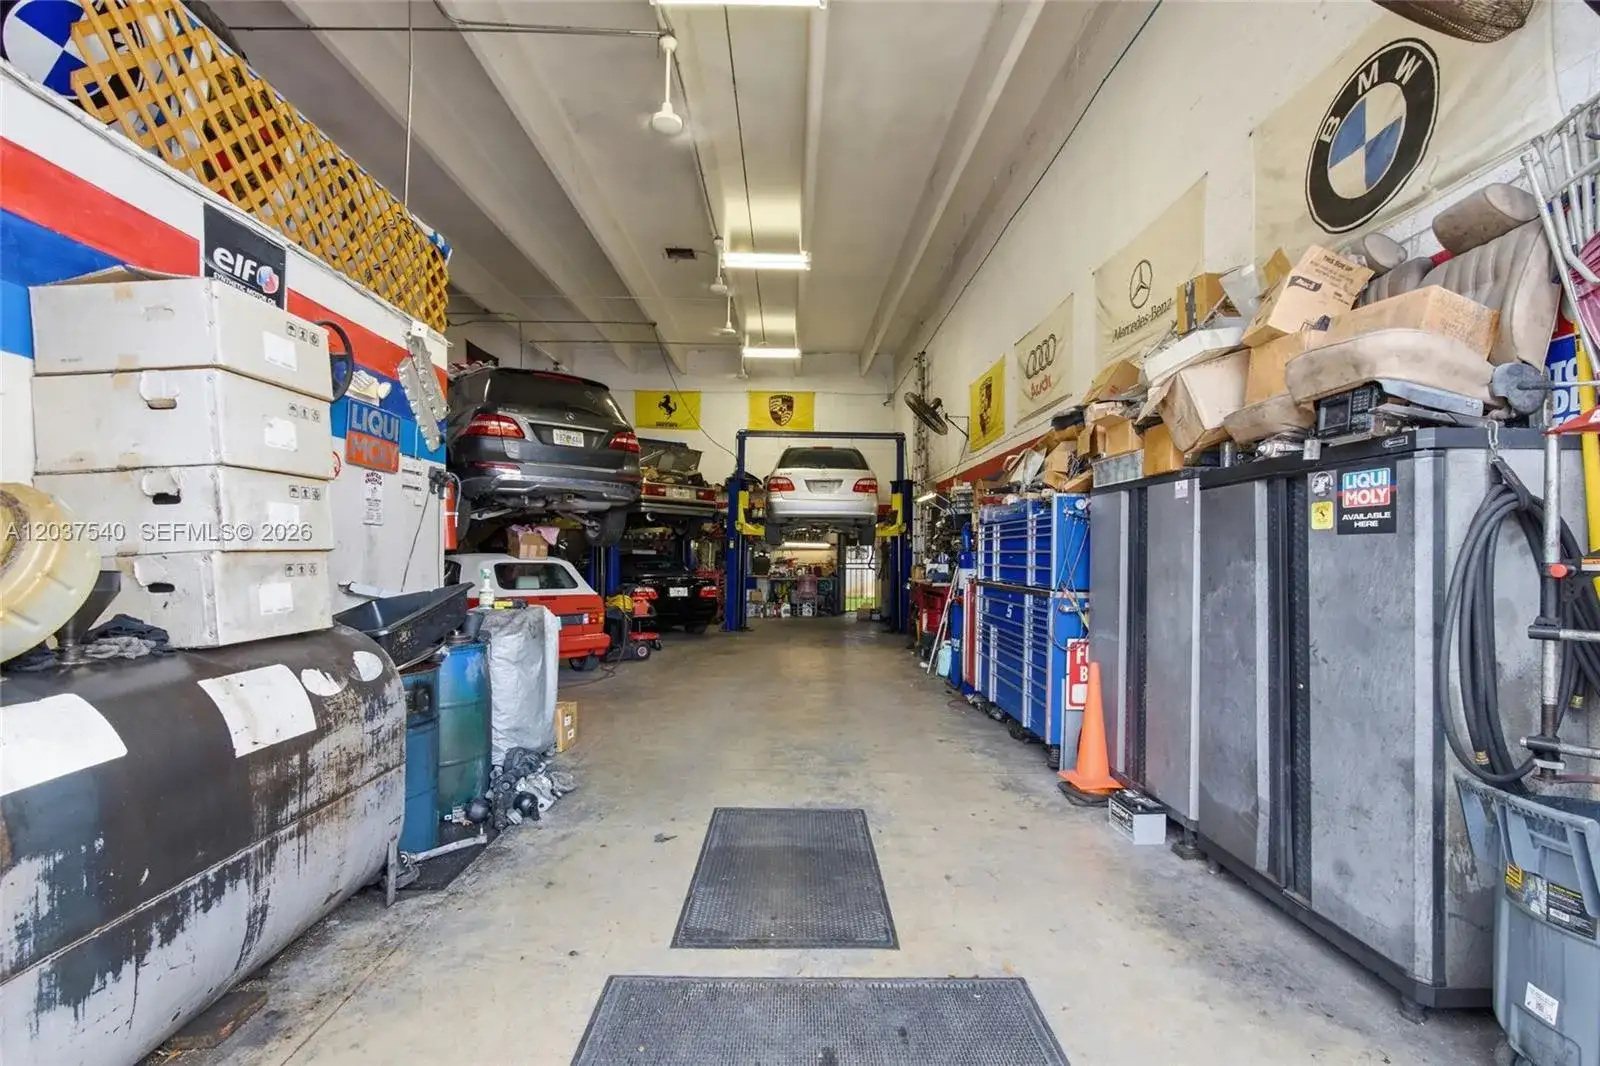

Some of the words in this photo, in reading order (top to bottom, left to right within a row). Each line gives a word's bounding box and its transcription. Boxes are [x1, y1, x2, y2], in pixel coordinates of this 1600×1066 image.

[1319, 50, 1423, 143] BMW
[212, 247, 257, 282] elf
[1112, 297, 1172, 343] Mercedes-Benz
[1030, 375, 1052, 399] Audi
[351, 404, 399, 441] LIQUI
[350, 436, 399, 466] MOLY
[1345, 469, 1388, 489] LIQUI
[1345, 487, 1388, 506] MOLY
[1341, 511, 1391, 521] AVAILABLE
[1353, 519, 1379, 528] HERE
